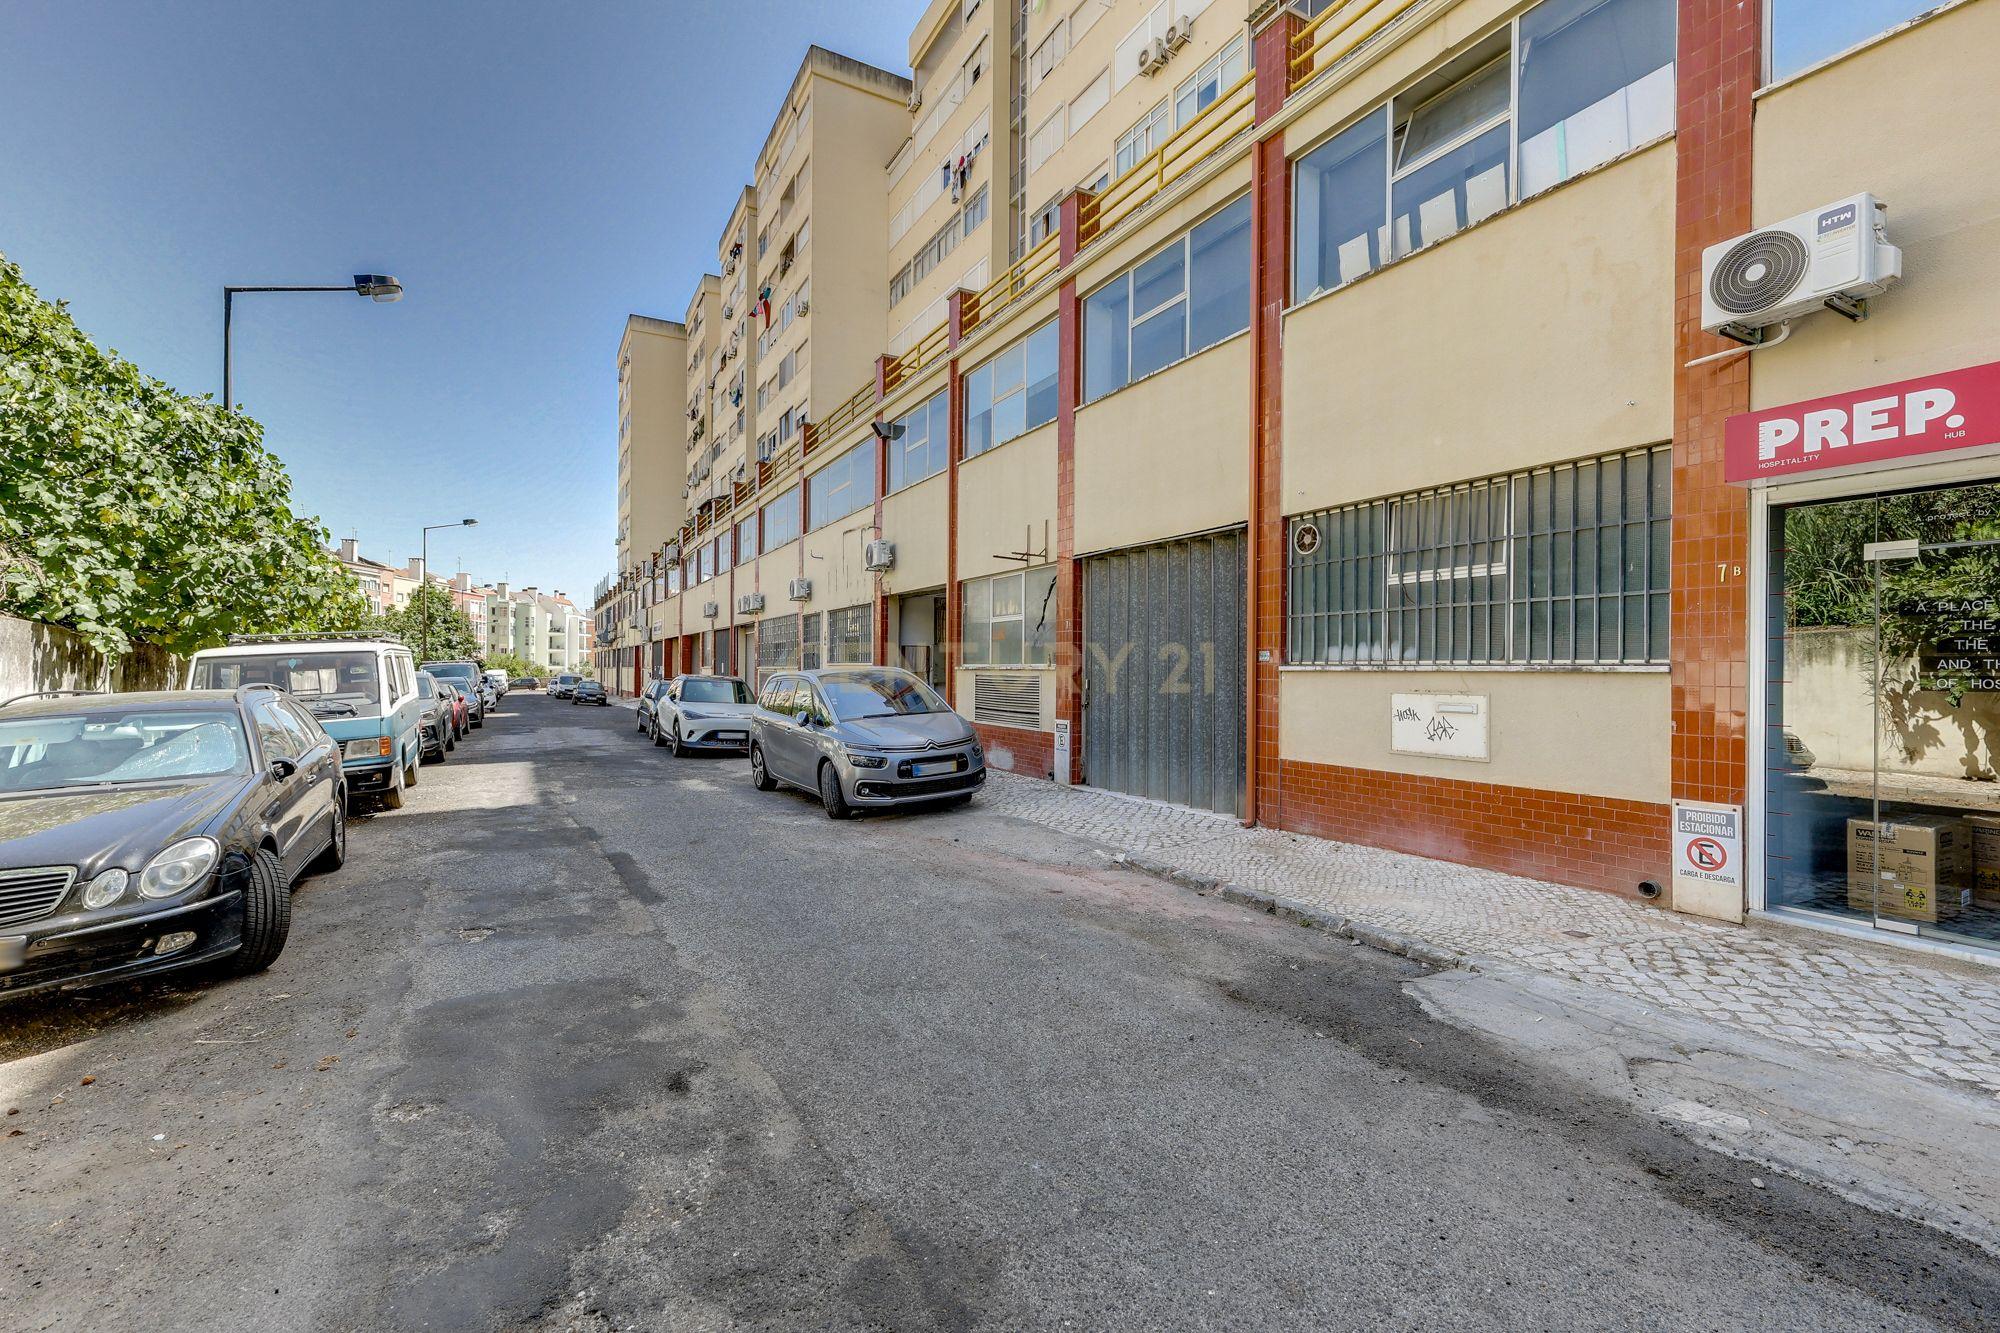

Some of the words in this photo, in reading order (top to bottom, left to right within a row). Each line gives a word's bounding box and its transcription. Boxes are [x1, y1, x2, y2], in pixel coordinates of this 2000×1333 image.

[1822, 211, 1852, 227] HTW
[1758, 388, 1965, 461] PREP.
[1944, 429, 1966, 440] HUB
[1758, 453, 1820, 470] HOSPITALITY
[1978, 508, 1991, 517] by
[1717, 563, 1727, 583] 7
[1733, 565, 1742, 577] B
[1916, 602, 1926, 612] A
[1937, 600, 1994, 613] PLACE
[1962, 620, 1995, 630] THE
[1954, 640, 1988, 650] THE
[1936, 659, 1971, 670] AND
[1936, 678, 1958, 689] OF
[1686, 811, 1726, 824] PROIBIDO
[1680, 821, 1734, 836] ESTACIONAR
[1680, 868, 1698, 878] CARGA
[1704, 873, 1736, 884] DESCARGA
